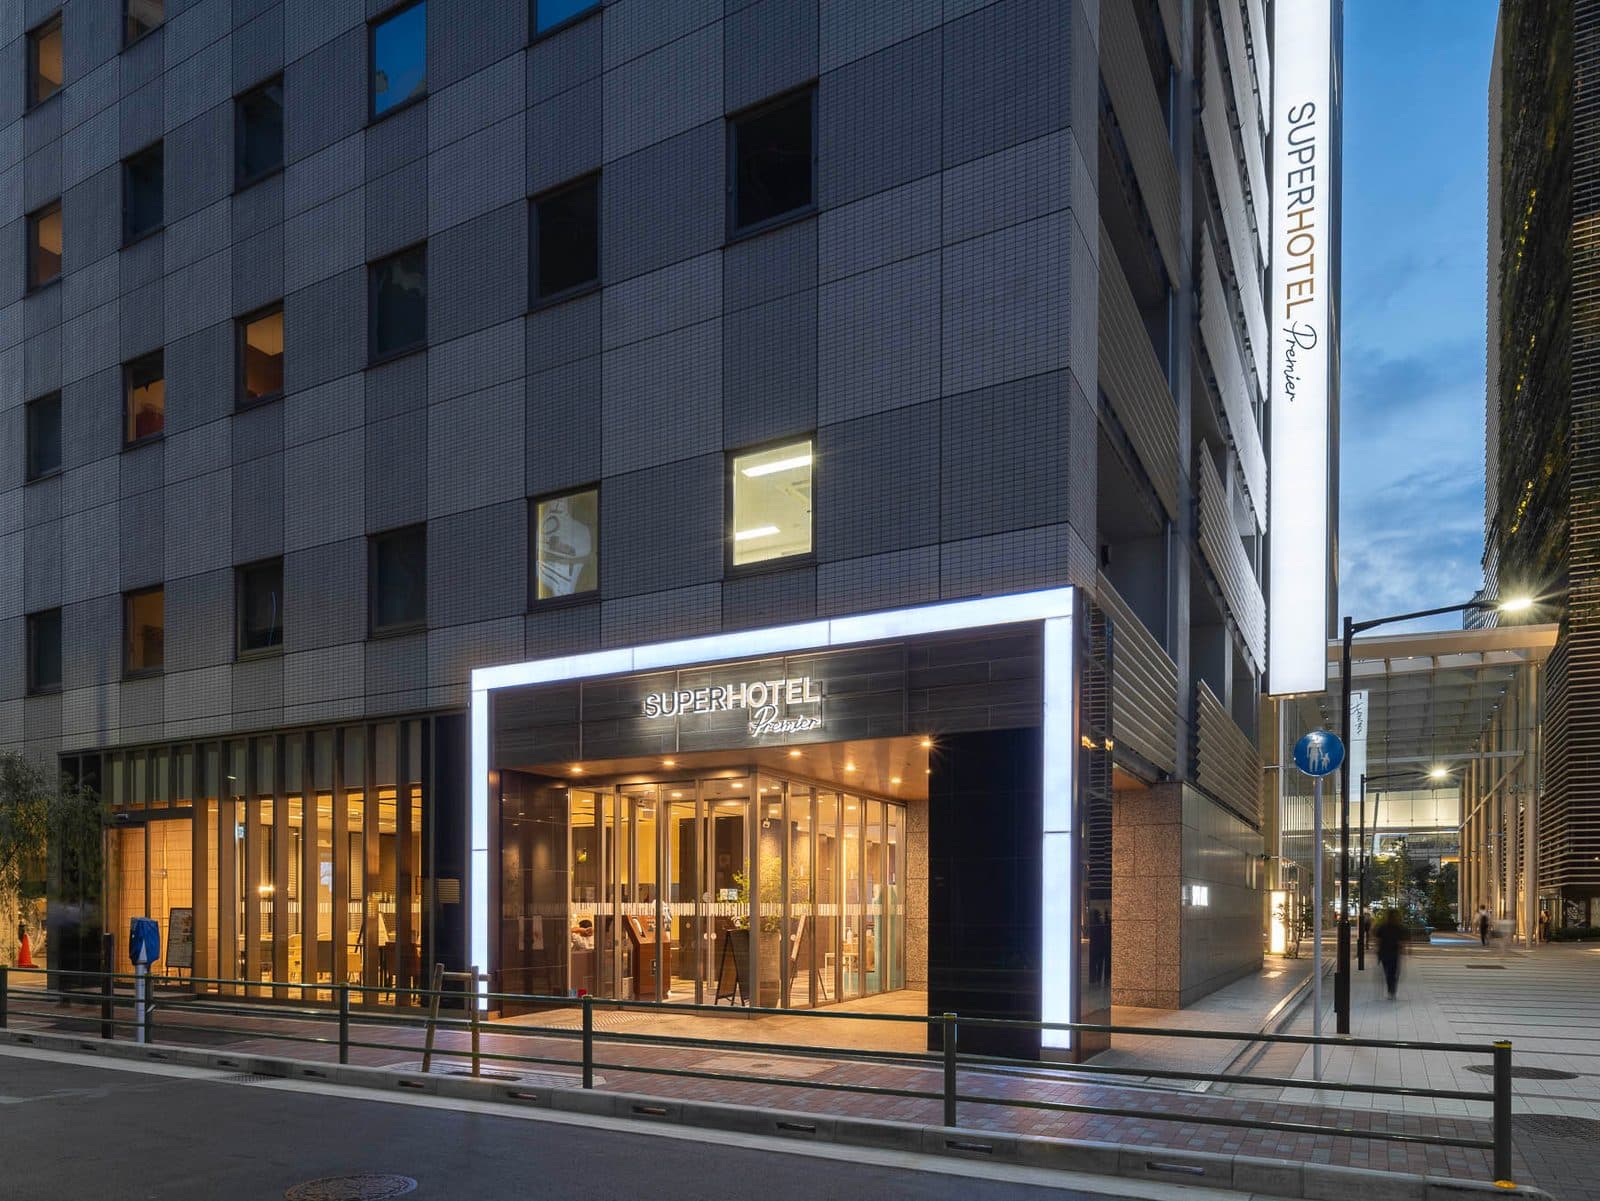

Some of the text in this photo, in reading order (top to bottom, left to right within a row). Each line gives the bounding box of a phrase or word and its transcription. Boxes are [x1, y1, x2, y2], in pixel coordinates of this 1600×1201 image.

[1284, 101, 1317, 402] SUPERHOTEL Premier
[643, 678, 821, 718] SUPERHOTEL
[749, 706, 821, 737] Premier
